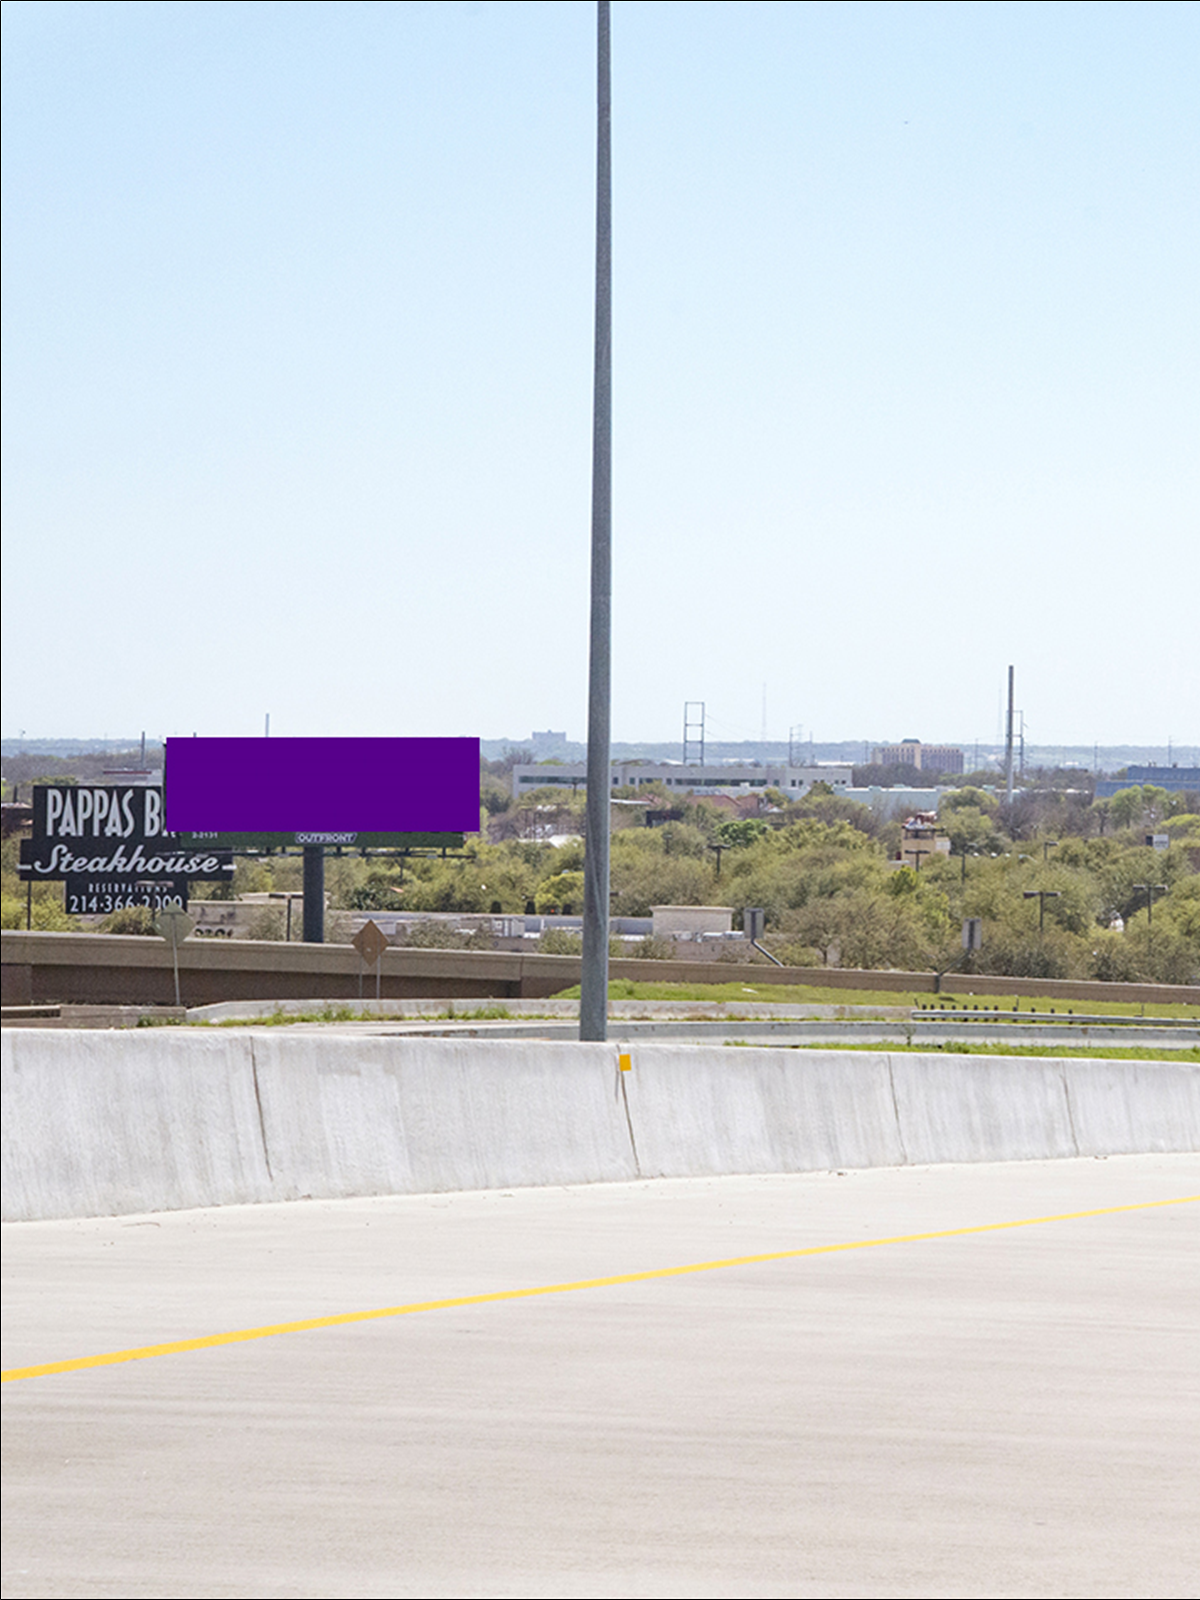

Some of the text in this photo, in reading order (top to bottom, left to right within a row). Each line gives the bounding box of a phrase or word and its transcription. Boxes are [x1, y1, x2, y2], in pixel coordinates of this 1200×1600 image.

[46, 788, 135, 838] PAPPAS
[297, 832, 356, 843] OUTFRONT
[34, 844, 219, 873] Steakhouse
